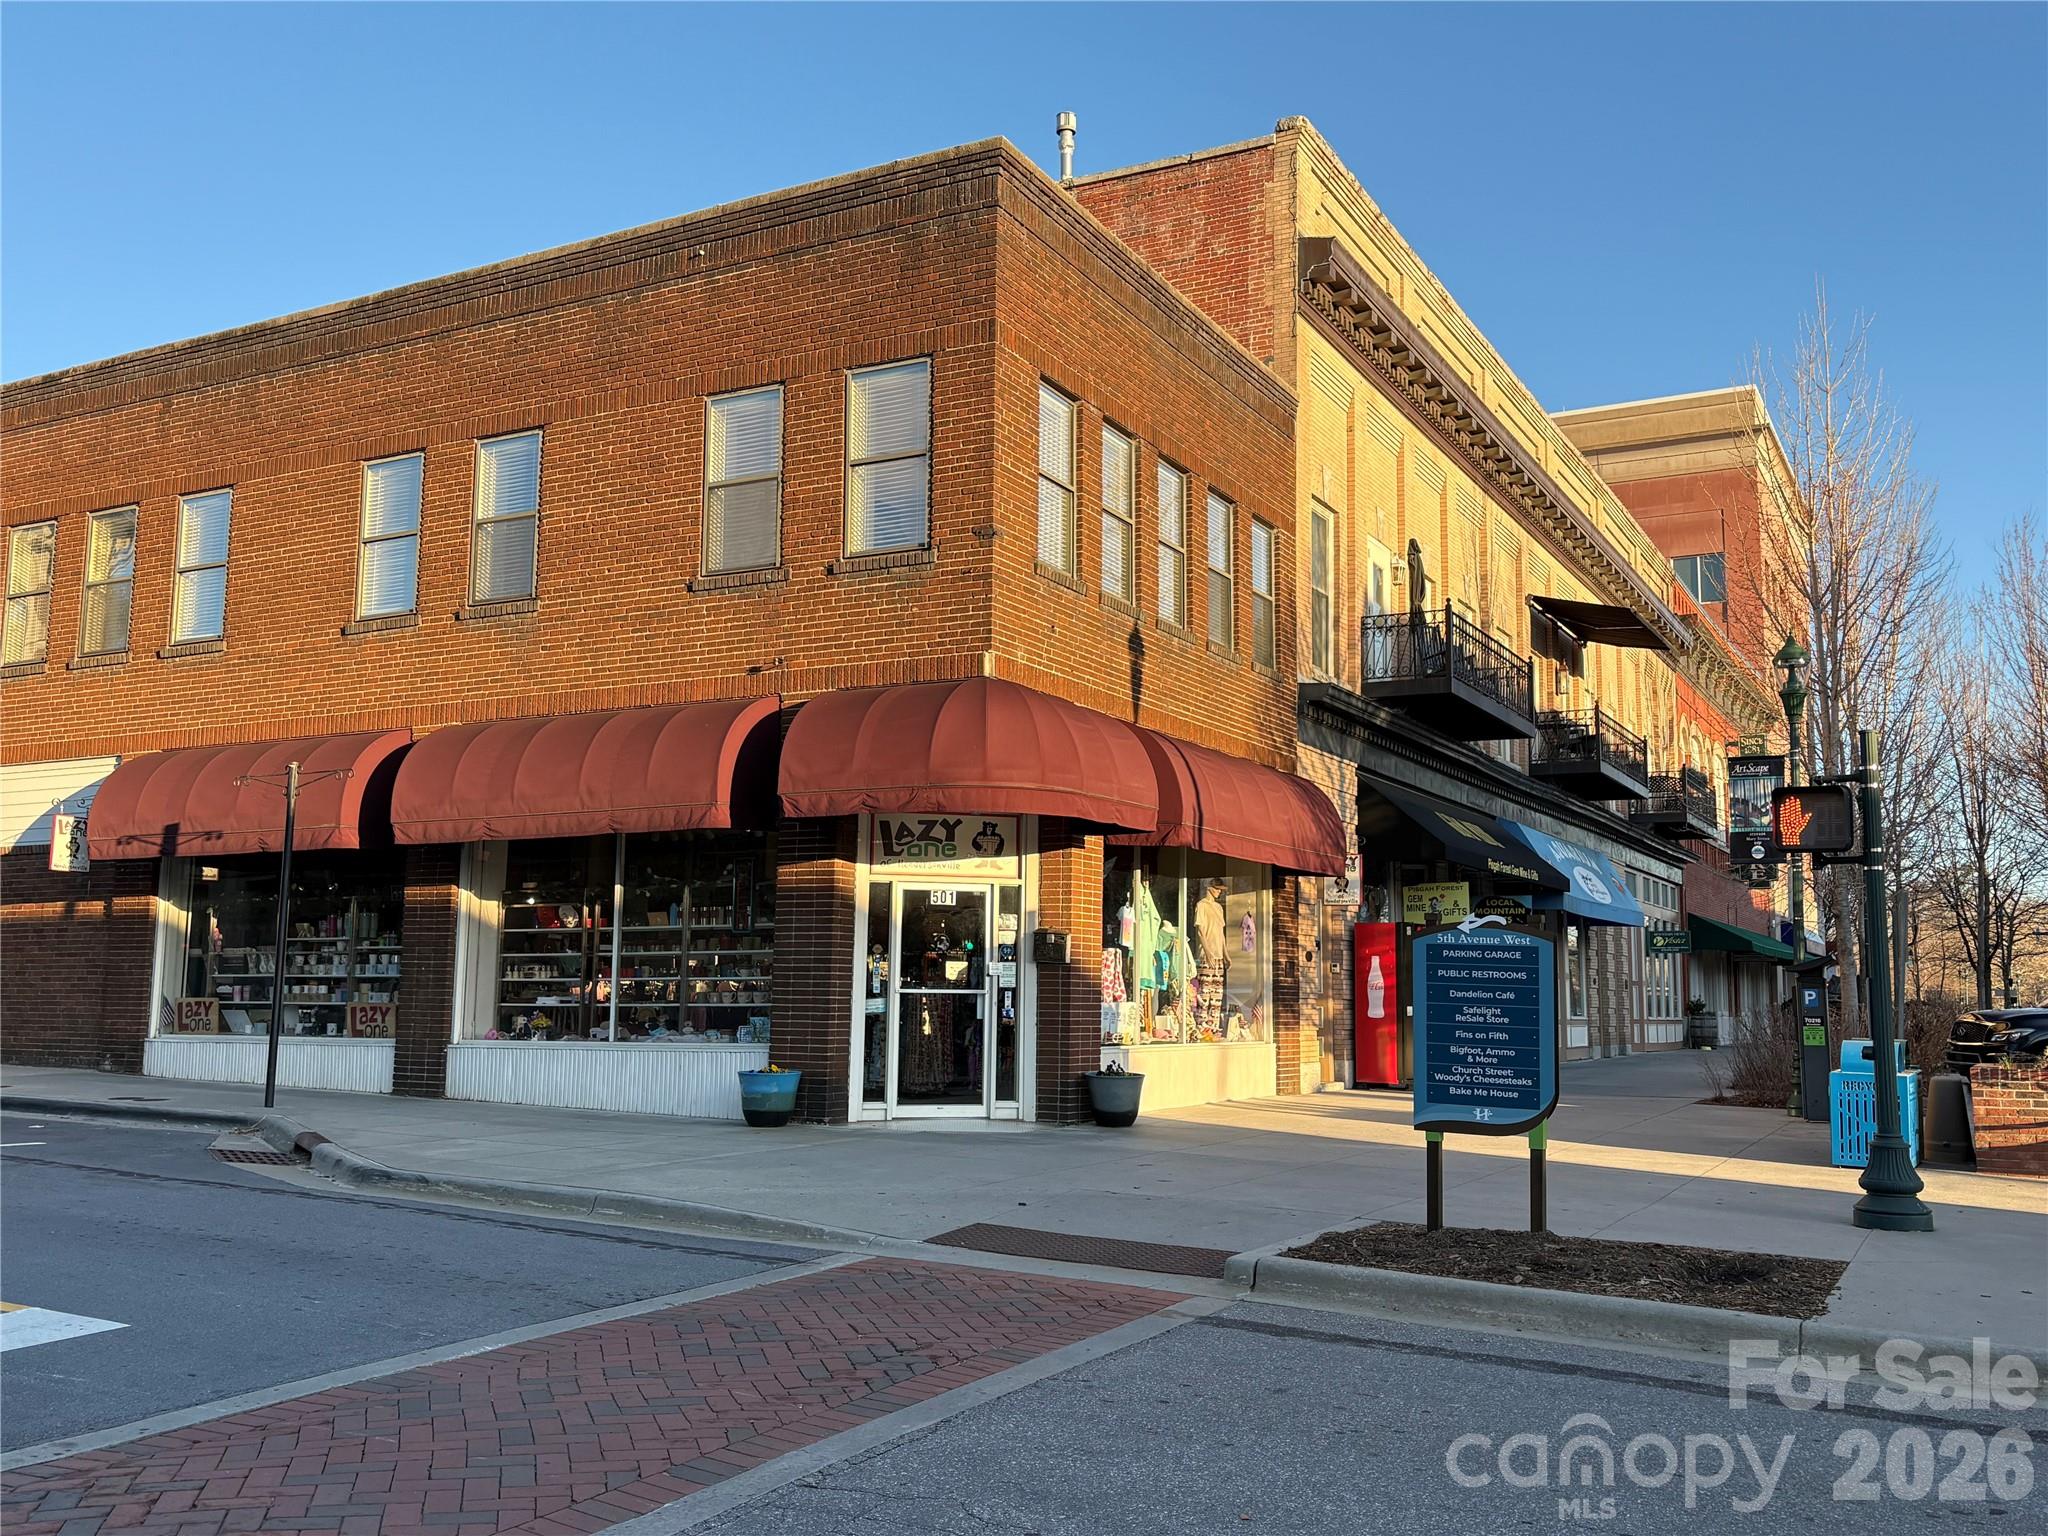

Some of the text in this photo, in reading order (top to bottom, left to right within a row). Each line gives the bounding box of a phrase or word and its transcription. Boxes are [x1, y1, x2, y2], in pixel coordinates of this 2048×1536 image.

[932, 890, 955, 904] 501
[1408, 895, 1424, 903] GEM
[1406, 904, 1427, 912] MINE
[1453, 900, 1460, 908] &
[1443, 908, 1468, 917] GIFTS
[1436, 933, 1531, 945] 5th Avenue West
[1442, 950, 1522, 960] PARKING GARAGE
[1437, 969, 1527, 980] PUBLIC RESTROOMS
[1449, 990, 1516, 1000] Dandelion Café
[1804, 991, 1817, 1005] P
[1463, 1006, 1502, 1016] Safelight
[1455, 1014, 1510, 1024] ReSale Store
[1455, 1030, 1509, 1041] Fins on Fifth
[1450, 1045, 1516, 1057] Bigfoot, Ammo
[1474, 1056, 1498, 1064] More
[1452, 1066, 1514, 1077] Church Street:
[1434, 1073, 1532, 1086] Woody's Cheesesteaks
[1449, 1086, 1519, 1098] Bake Me House
